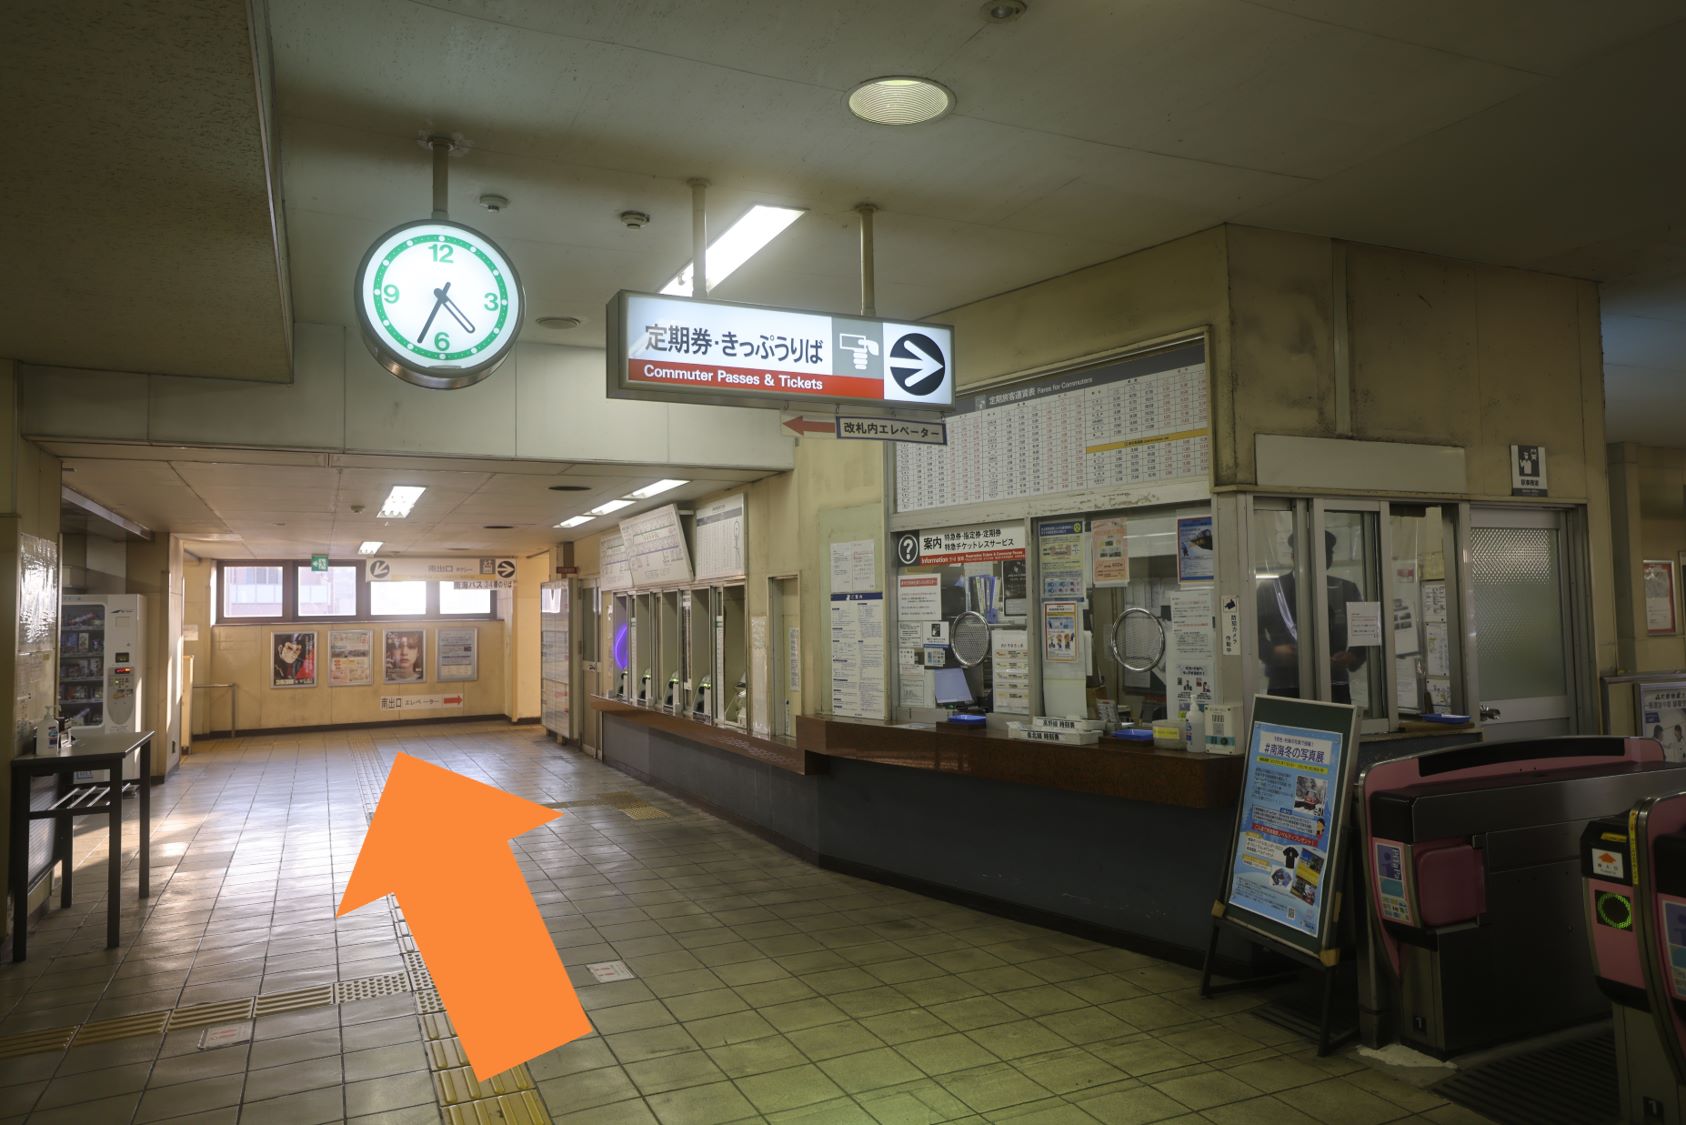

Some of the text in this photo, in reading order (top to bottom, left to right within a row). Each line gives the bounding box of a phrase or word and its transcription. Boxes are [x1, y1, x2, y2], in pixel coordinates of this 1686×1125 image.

[428, 244, 454, 264] 12
[383, 284, 400, 304] 9
[483, 292, 499, 312] 3
[433, 331, 450, 351] 6
[645, 324, 823, 364] 定期券・きっぷうりば
[644, 364, 823, 391] Commuter Passes & Tickets
[1061, 377, 1093, 389] Commuters
[844, 421, 940, 439] 改札内エレベーター
[923, 537, 942, 550] 案内
[944, 538, 1014, 551] 特急チケットレスサービス
[381, 697, 401, 709] 南出口
